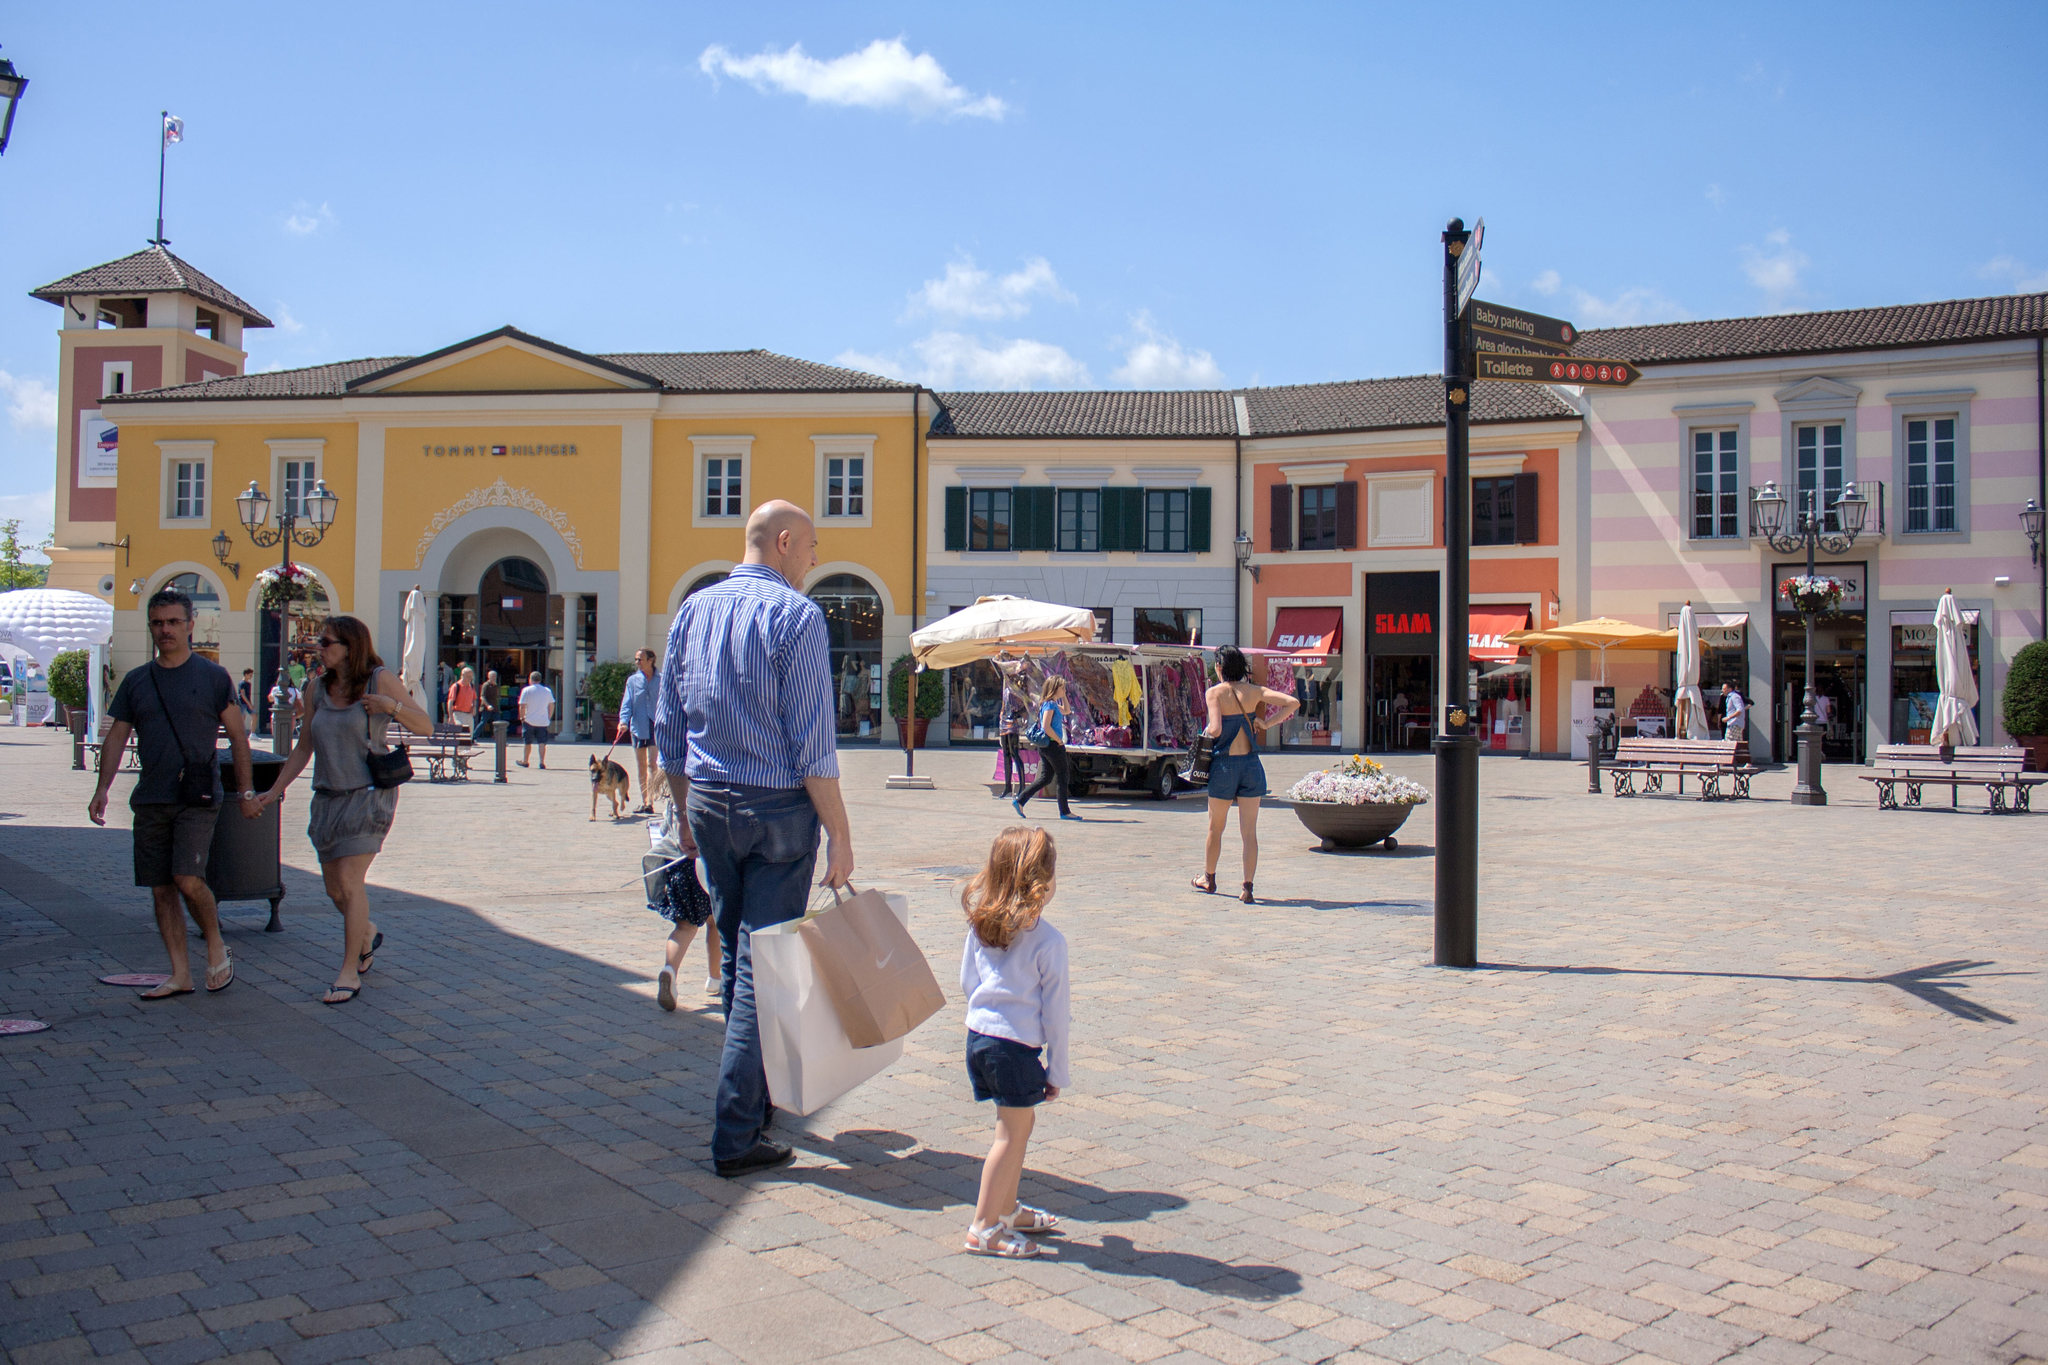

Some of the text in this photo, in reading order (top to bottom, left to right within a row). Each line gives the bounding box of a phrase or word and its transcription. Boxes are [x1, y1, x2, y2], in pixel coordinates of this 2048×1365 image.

[1476, 308, 1534, 336] Baby parking
[1476, 336, 1496, 352] Area
[1484, 360, 1534, 376] Toilette
[423, 444, 578, 457] TOMMY HILFIGER
[1375, 613, 1433, 634] SLAM
[1277, 634, 1322, 648] SLAM
